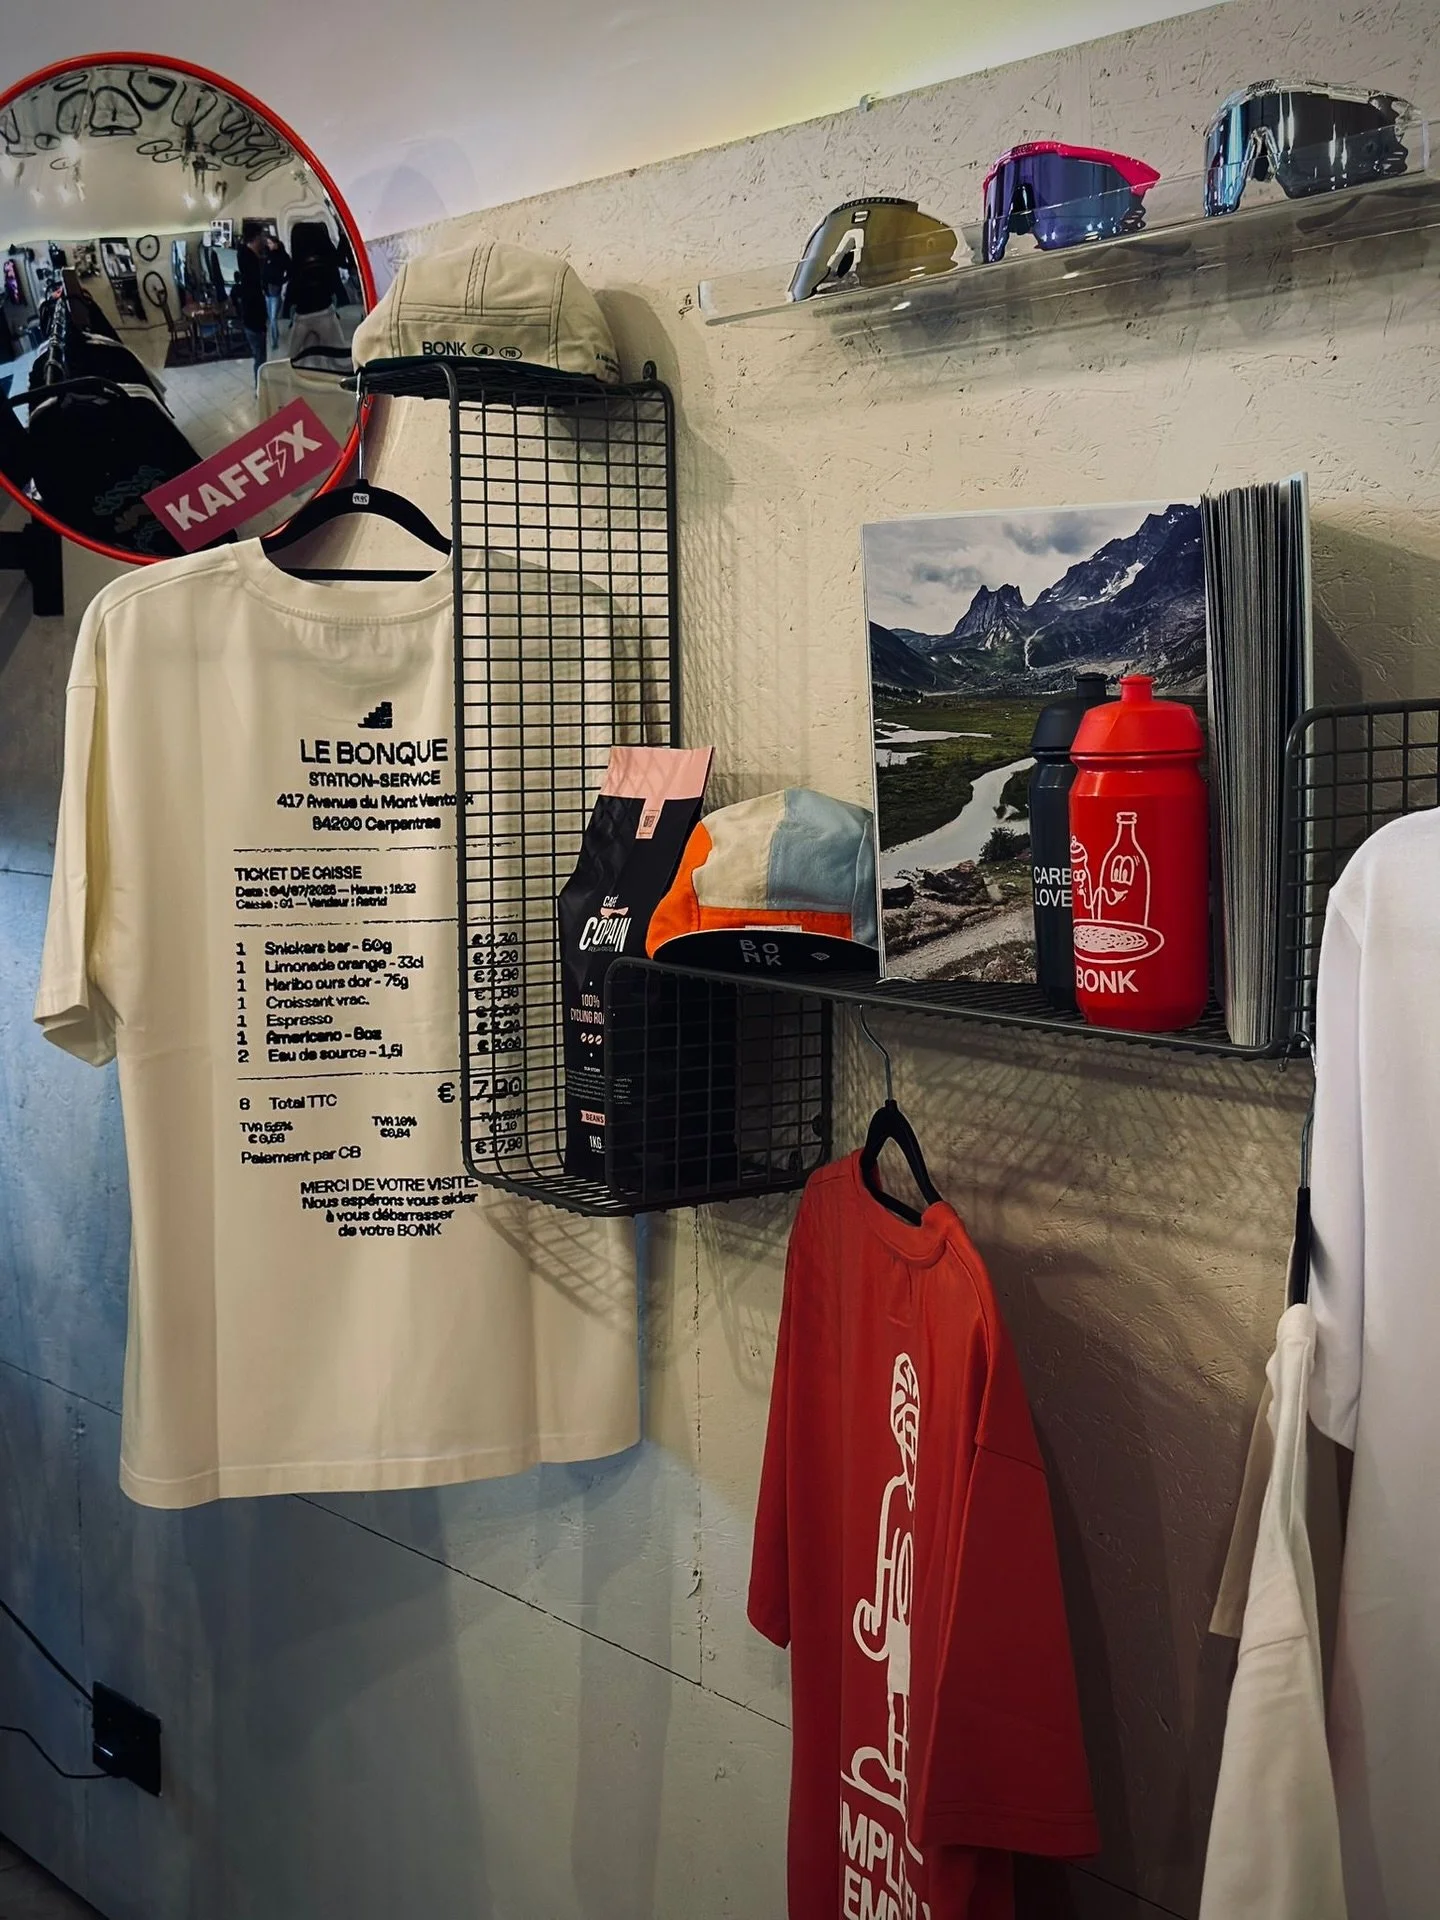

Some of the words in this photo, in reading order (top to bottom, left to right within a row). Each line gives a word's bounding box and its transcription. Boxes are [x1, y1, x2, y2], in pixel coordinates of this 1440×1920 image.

[422, 341, 467, 356] BONK
[300, 739, 330, 763] LE
[337, 738, 448, 766] BONQUE
[309, 770, 441, 787] STATION-SERVICE
[277, 793, 304, 808] 417
[307, 793, 358, 809] Avenue
[360, 793, 378, 809] du
[382, 793, 418, 808] Mont
[419, 792, 473, 808] Ventox
[366, 816, 441, 833] Carpentras
[234, 866, 288, 881] TICKET
[291, 867, 310, 880] DE
[312, 866, 362, 880] CAISSE
[579, 916, 632, 952] COPAIN
[236, 942, 246, 955] 1
[265, 940, 325, 956] Snickers
[327, 940, 350, 954] bar
[236, 960, 246, 974] 1
[265, 958, 335, 973] Limonade
[337, 958, 387, 973] orange
[397, 956, 423, 969] 33cl
[236, 978, 246, 992] 1
[265, 977, 313, 992] Haribo
[315, 978, 345, 989] ours
[383, 973, 408, 990] 75g
[1076, 967, 1139, 994] BONK
[237, 996, 247, 1009] 1
[266, 995, 334, 1009] Croissant
[335, 995, 370, 1006] vrac.
[581, 994, 600, 1008] 100%
[237, 1014, 247, 1028] 1
[266, 1014, 333, 1029] Espresso
[237, 1031, 248, 1045] 1
[266, 1029, 342, 1045] Americano
[238, 1049, 249, 1063] 2
[268, 1048, 296, 1062] Eau
[299, 1047, 317, 1061] de
[319, 1048, 367, 1060] source
[269, 1095, 305, 1109] Total
[306, 1094, 337, 1108] TTC
[437, 1082, 455, 1103] €
[240, 1122, 263, 1132] TVA
[371, 1116, 393, 1127] TVA
[585, 1112, 604, 1123] BEANS
[589, 1135, 602, 1149] 1KG
[241, 1151, 310, 1165] Paiement
[313, 1149, 336, 1164] par
[338, 1146, 361, 1159] CB
[301, 1178, 349, 1194] MERCI
[352, 1178, 375, 1191] DE
[376, 1177, 425, 1191] VOTRE
[302, 1196, 338, 1209] Nous
[341, 1193, 404, 1208] espérons
[407, 1196, 439, 1206] vous
[441, 1191, 478, 1205] aider
[326, 1208, 334, 1222] à
[336, 1211, 370, 1221] vous
[372, 1207, 454, 1221] débarrasser
[338, 1224, 356, 1236] de
[359, 1225, 394, 1236] votre
[398, 1223, 442, 1236] BONK
